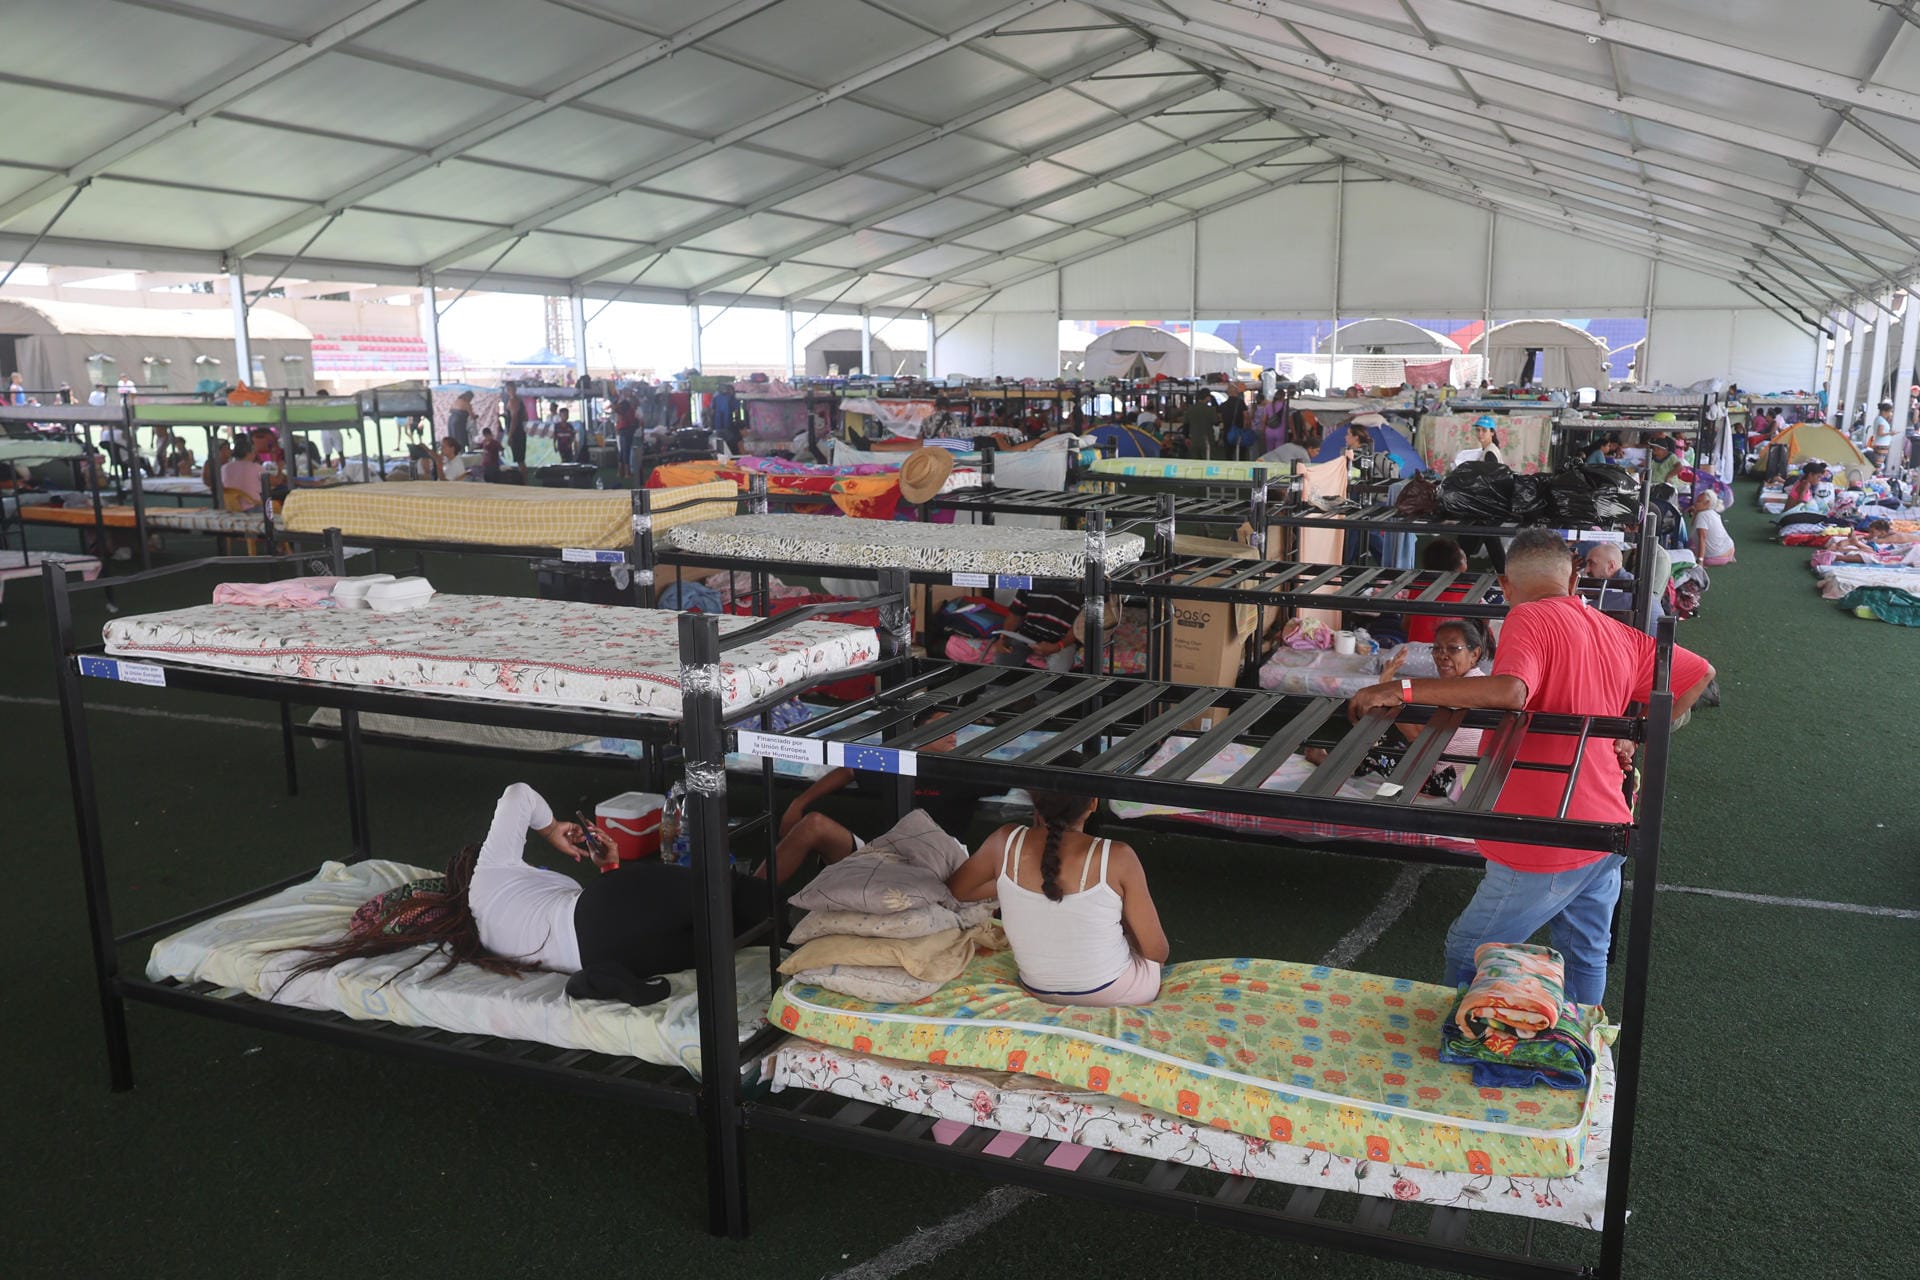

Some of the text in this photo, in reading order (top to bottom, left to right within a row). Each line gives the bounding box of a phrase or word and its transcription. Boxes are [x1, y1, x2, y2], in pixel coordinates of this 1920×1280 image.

[757, 735, 791, 745] Financiado
[780, 745, 807, 754] Europea
[772, 751, 810, 761] Humanitaria
